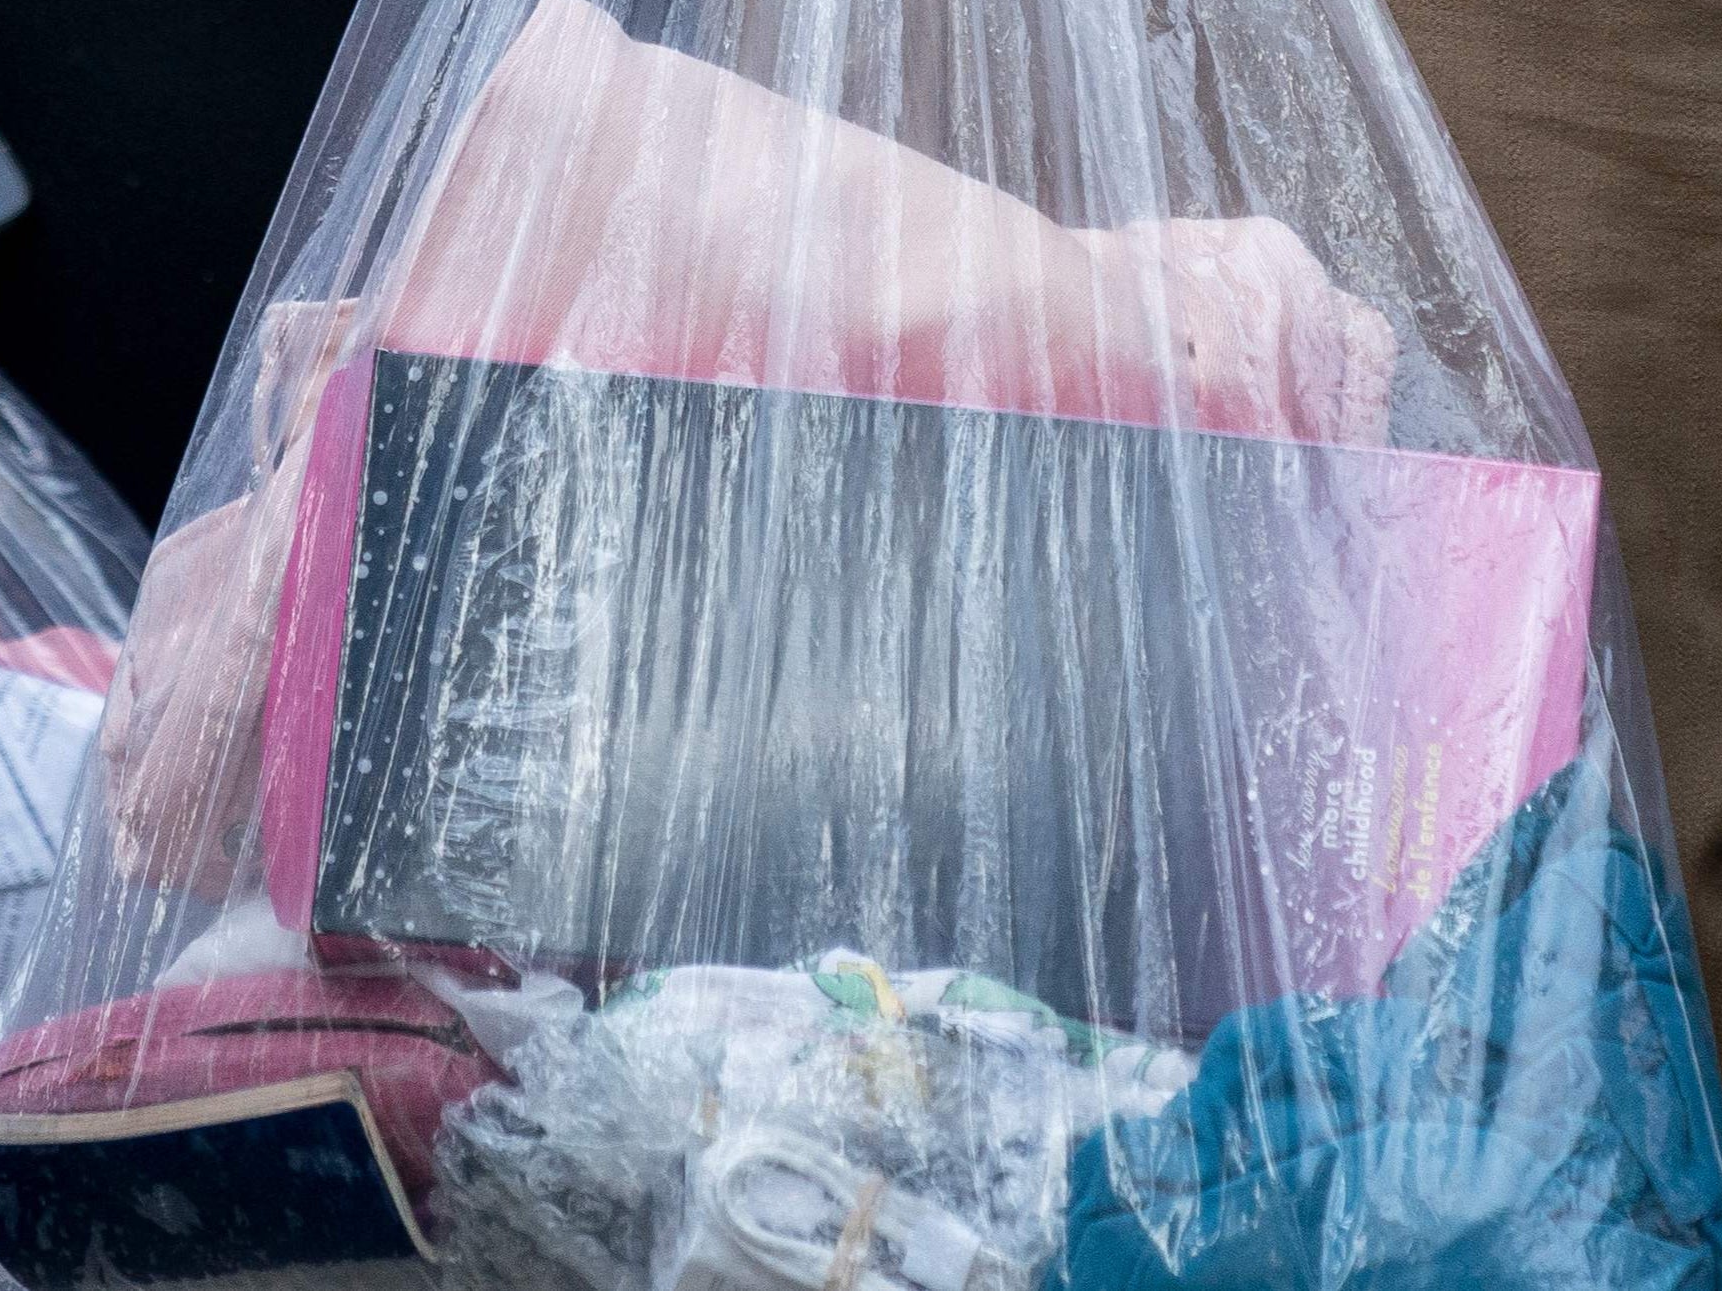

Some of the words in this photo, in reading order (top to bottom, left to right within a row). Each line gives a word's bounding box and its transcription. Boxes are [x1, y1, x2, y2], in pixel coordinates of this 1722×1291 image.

[1323, 780, 1341, 848] more
[1344, 747, 1377, 881] childhood
[1408, 869, 1433, 900] de
